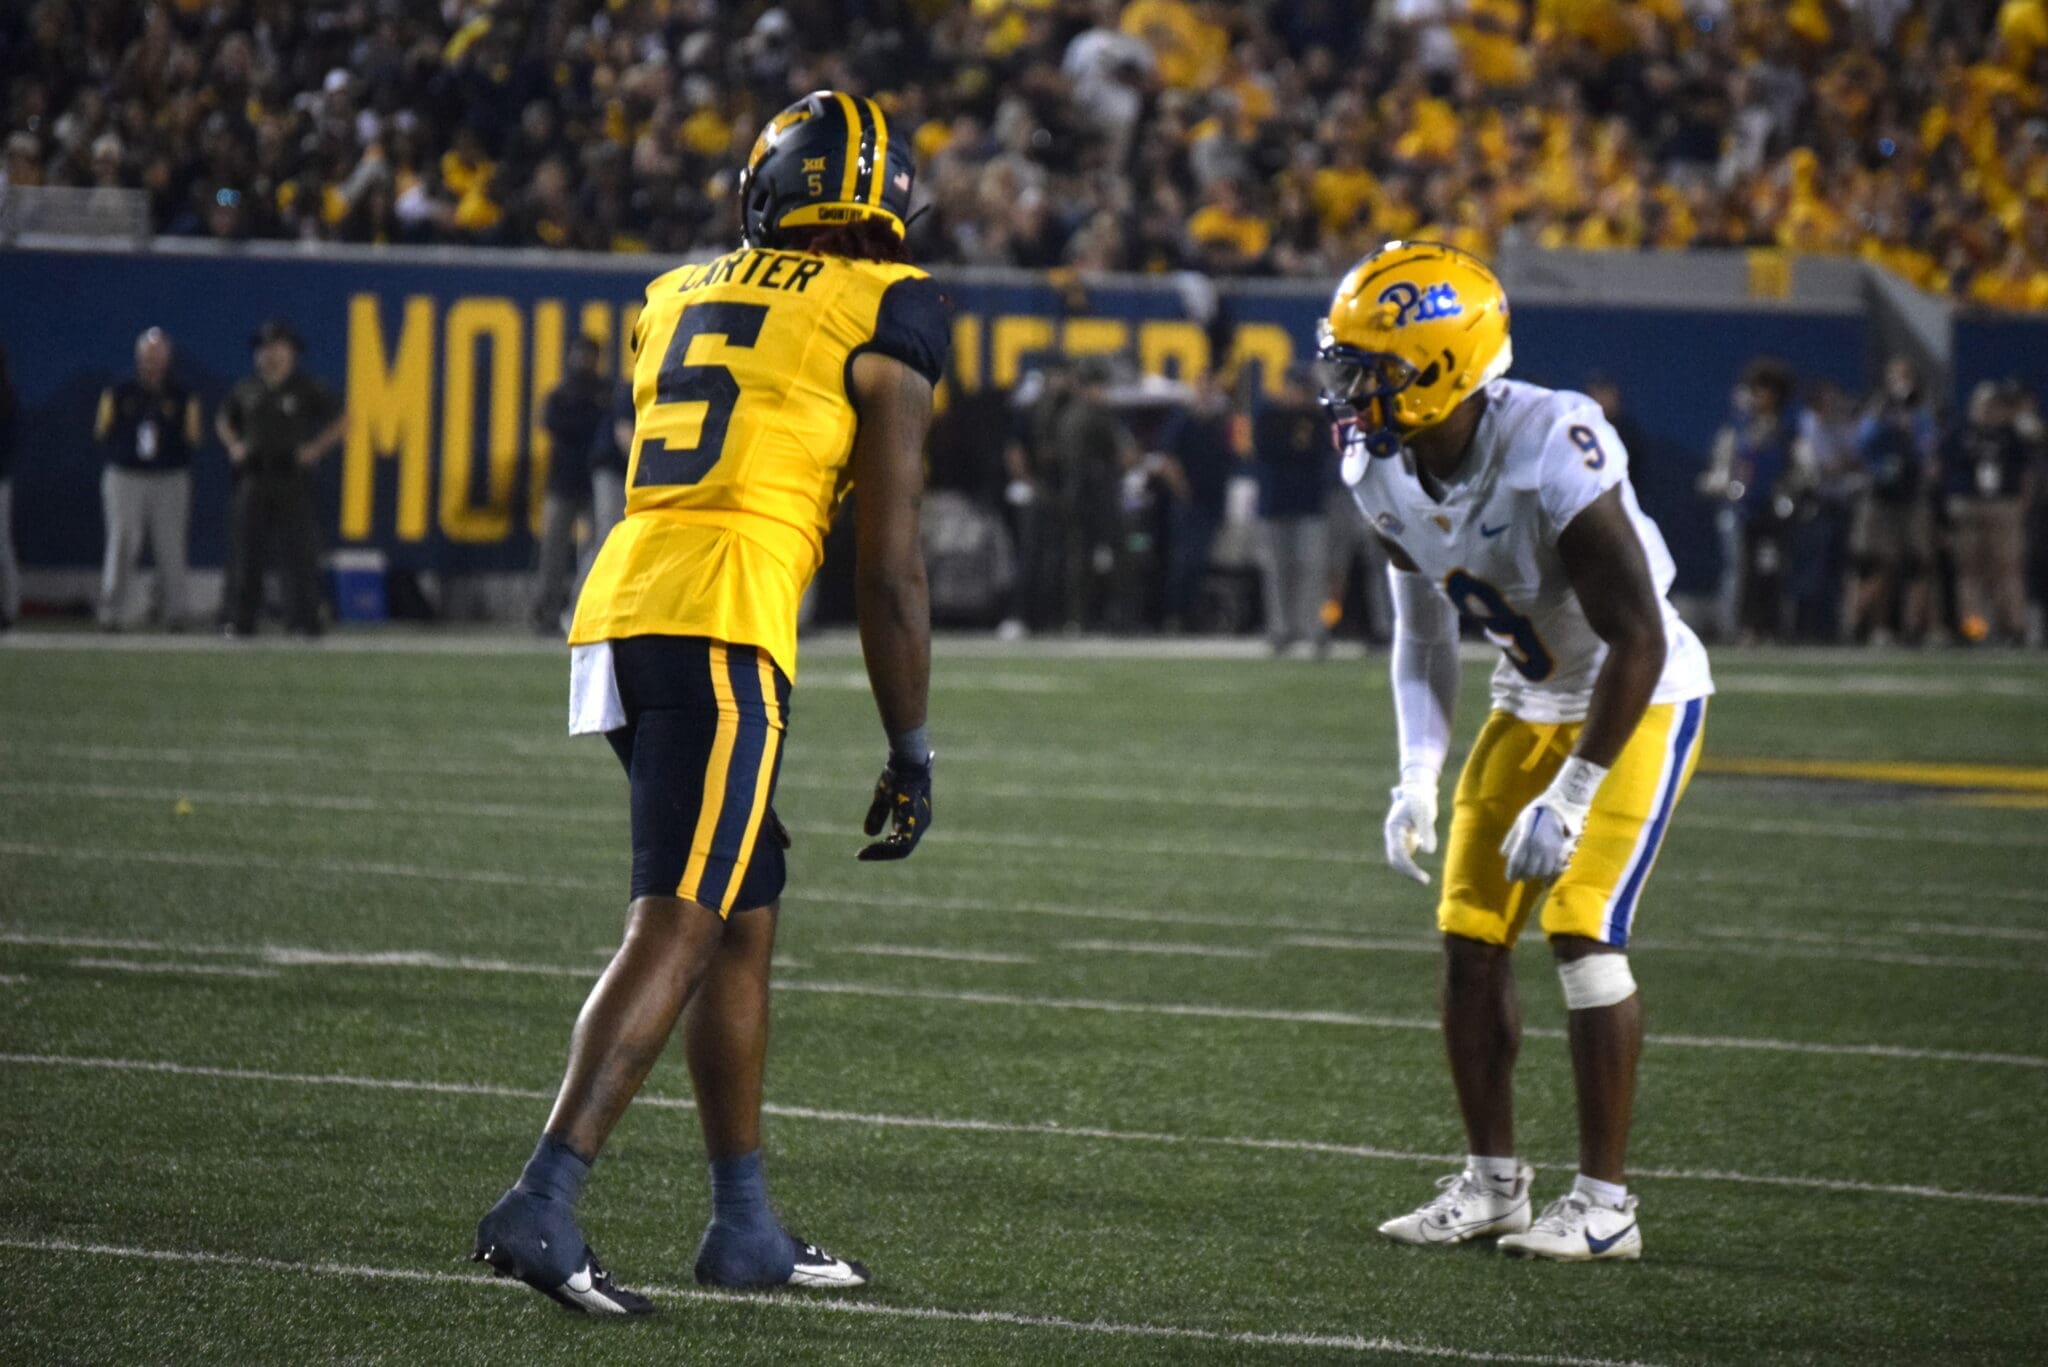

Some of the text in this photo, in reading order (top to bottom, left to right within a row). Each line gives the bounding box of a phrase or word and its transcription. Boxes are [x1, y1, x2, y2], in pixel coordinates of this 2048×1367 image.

[808, 174, 823, 196] 5
[1378, 281, 1462, 328] Pitt
[632, 302, 770, 488] 5
[1567, 424, 1606, 471] 9
[1443, 566, 1555, 683] 9
